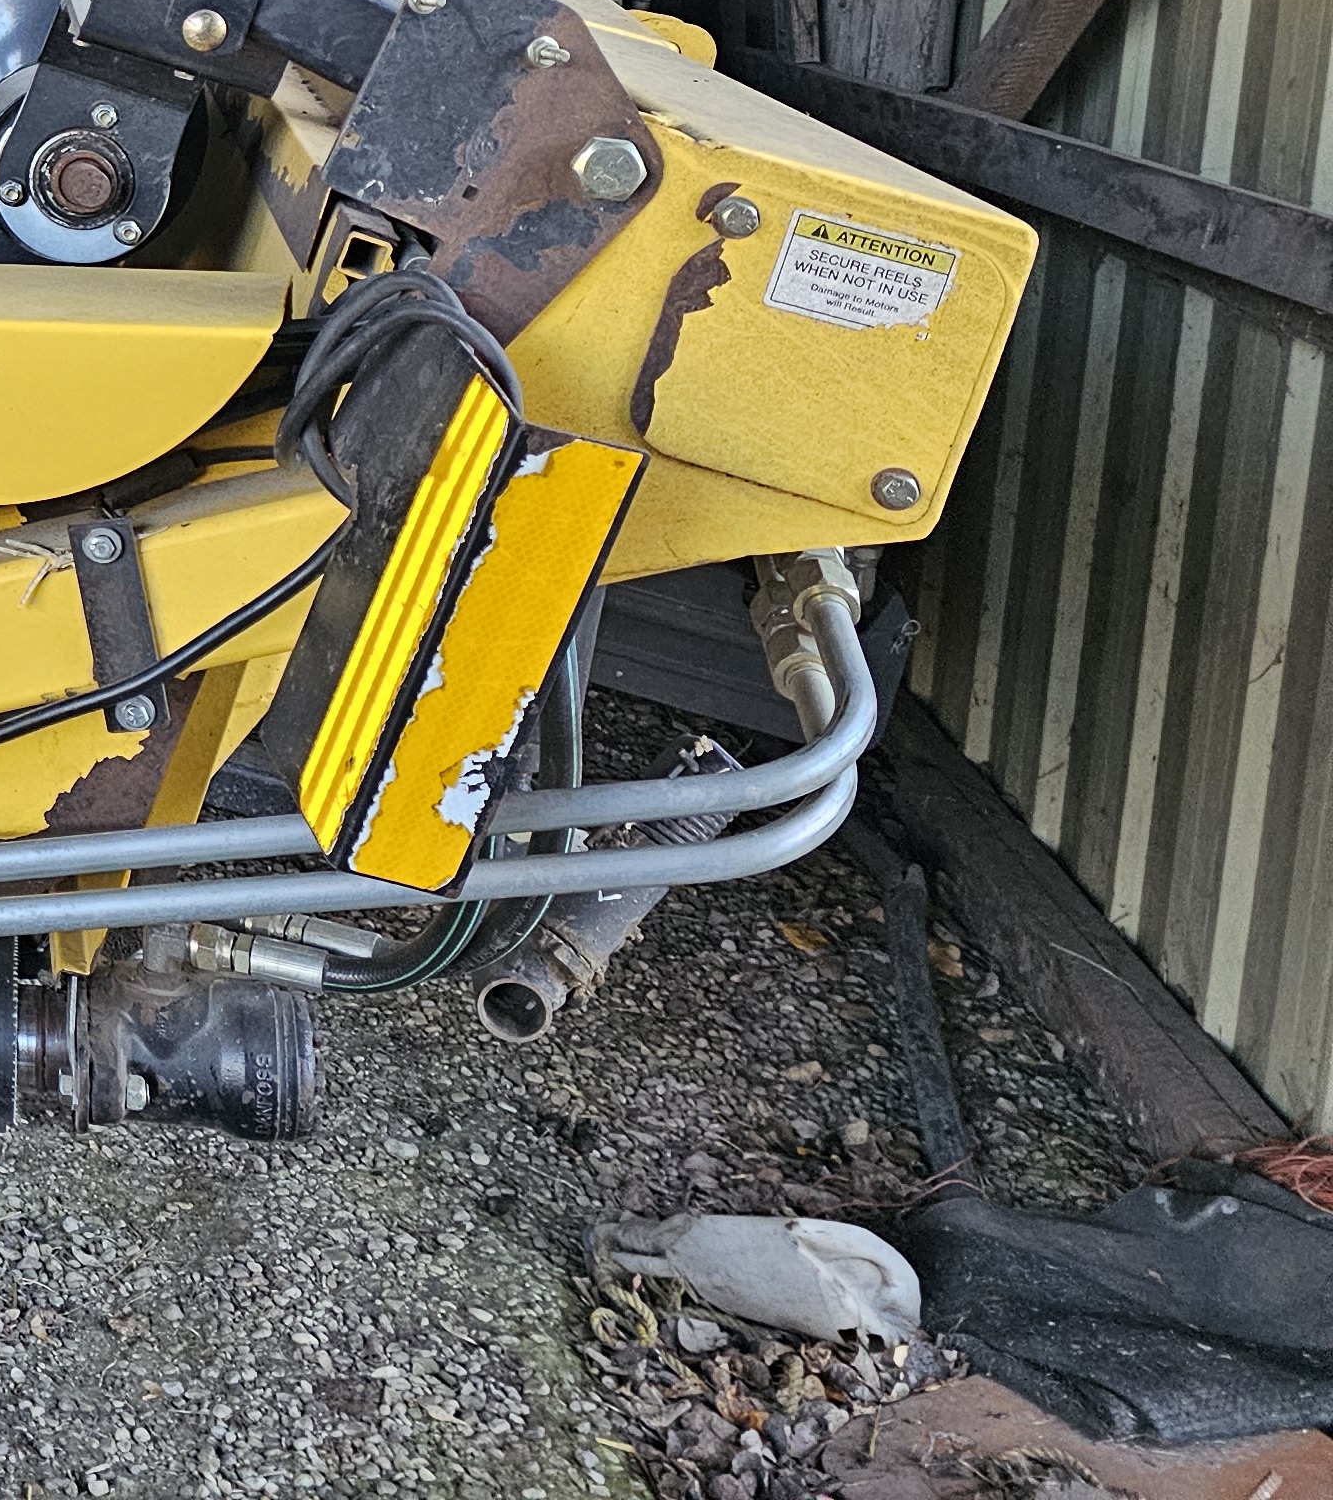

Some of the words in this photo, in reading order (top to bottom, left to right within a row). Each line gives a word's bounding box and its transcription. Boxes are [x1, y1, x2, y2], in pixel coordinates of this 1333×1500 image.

[836, 231, 936, 266] ATTENTION
[794, 260, 840, 281] WHEN
[842, 273, 876, 291] NOT
[878, 282, 894, 296] IN
[897, 286, 929, 305] USE
[809, 249, 872, 274] SECURE
[873, 265, 923, 288] REELS
[810, 283, 851, 301] Damage
[852, 294, 863, 304] to
[864, 298, 900, 313] Motors
[826, 298, 842, 309] will
[254, 1053, 274, 1135] DANFOSS
